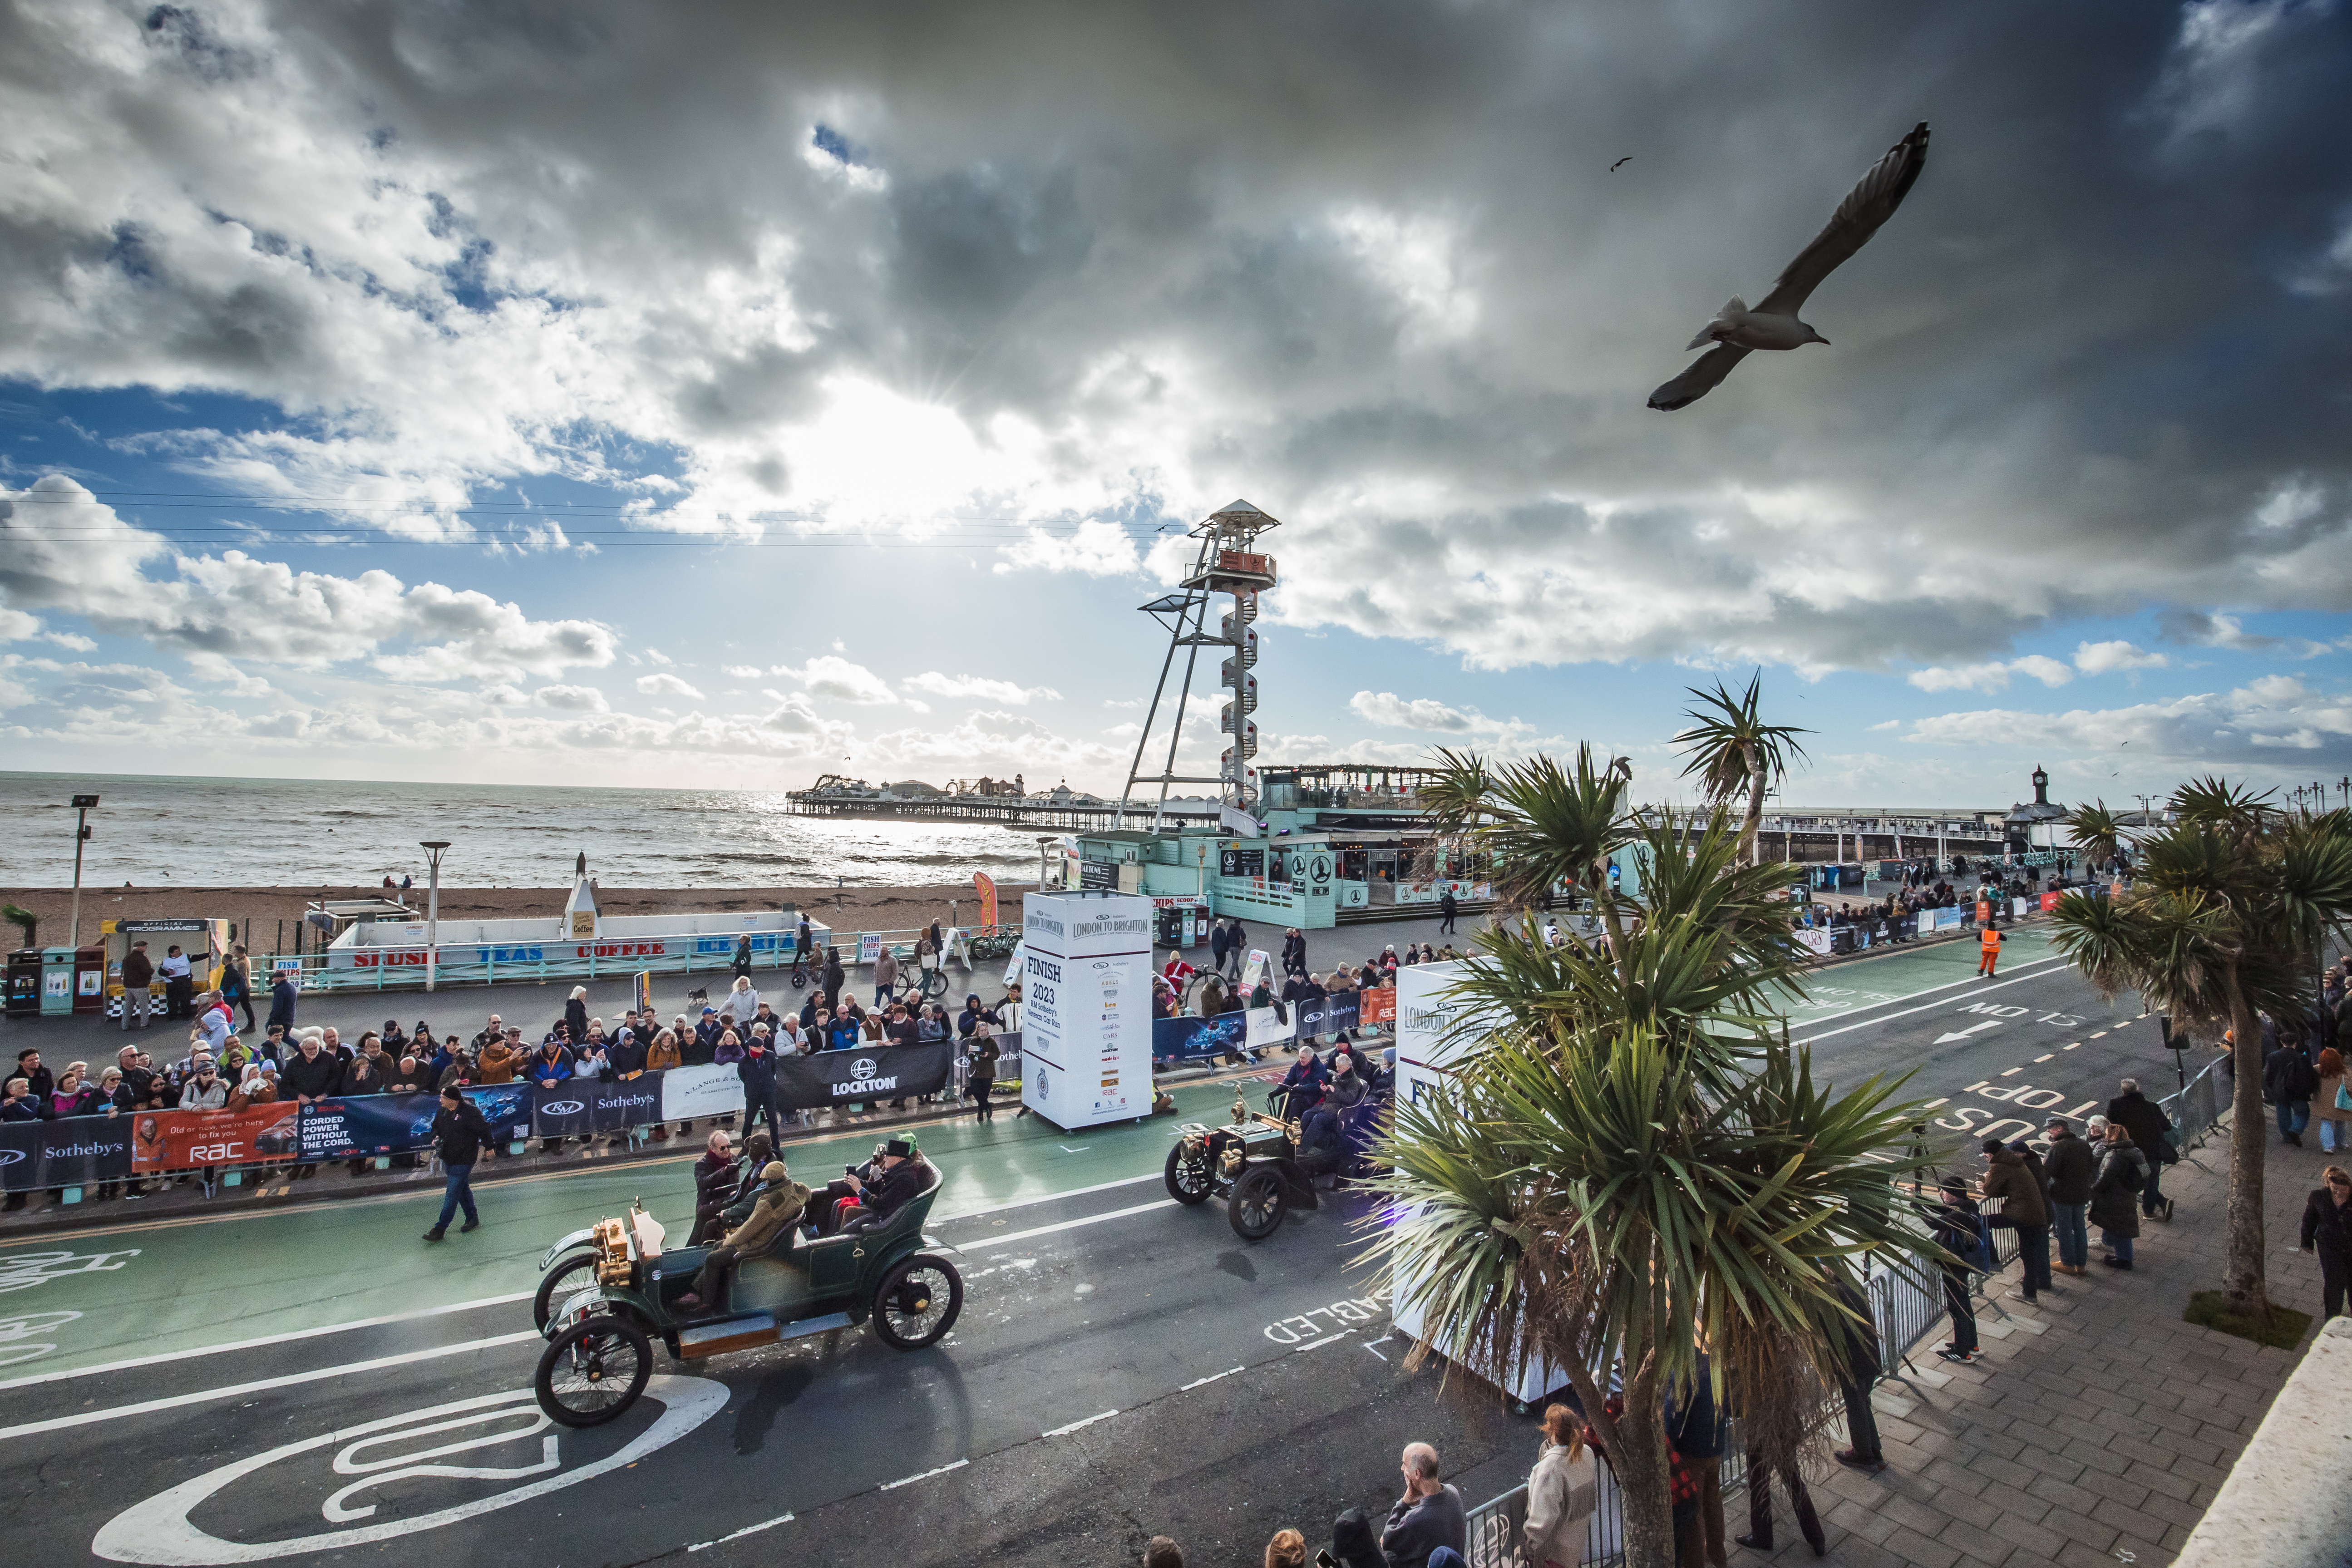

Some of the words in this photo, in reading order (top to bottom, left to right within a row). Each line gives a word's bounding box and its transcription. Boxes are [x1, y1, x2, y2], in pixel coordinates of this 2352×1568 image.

[1081, 865, 1101, 874] ALTONS
[1073, 922, 1102, 938] LONDON
[1104, 921, 1112, 931] TO
[1114, 919, 1148, 933] BRIGHTON
[477, 945, 543, 962] TEAS
[577, 940, 665, 958] COFFEE
[696, 937, 731, 953] ICE
[1027, 956, 1061, 983] FINISH
[1033, 982, 1055, 1005] 2023
[1805, 986, 1898, 1000] SLOW
[1031, 999, 1037, 1009] RM
[1038, 1003, 1057, 1017] Sotheby's
[1330, 1006, 1356, 1016] Sotheby's
[1956, 1002, 2086, 1026] SLOW
[1027, 1008, 1043, 1021] Veteran
[1052, 1019, 1060, 1029] Run
[1405, 1005, 1445, 1032] LONDON
[832, 1078, 896, 1095] LOCKTON
[597, 1094, 655, 1109] Sotheby's
[303, 1116, 344, 1126] CORDED
[303, 1124, 339, 1134] POWER
[170, 1126, 184, 1134] Old
[303, 1130, 349, 1141] WITHOUT
[45, 1141, 123, 1159] Sotheby's
[302, 1141, 321, 1149] THE
[323, 1138, 354, 1146] CORD.
[322, 1405, 561, 1523] 20
